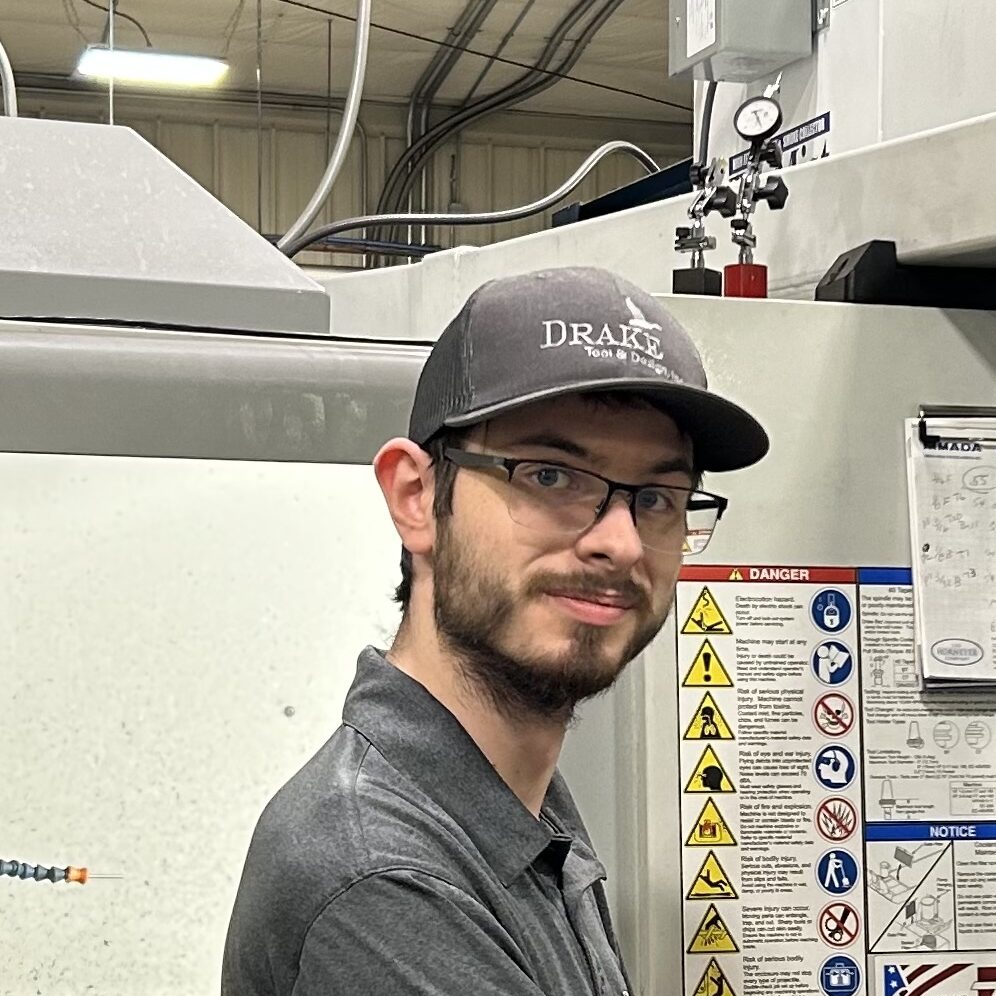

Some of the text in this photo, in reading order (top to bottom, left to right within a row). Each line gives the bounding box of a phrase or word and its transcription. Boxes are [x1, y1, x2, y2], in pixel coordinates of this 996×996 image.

[540, 319, 663, 360] DRAKE
[584, 346, 613, 358] Tool
[616, 349, 627, 359] &
[925, 443, 982, 452] MADA
[749, 568, 809, 580] DANGER
[930, 826, 976, 837] NOTICE
